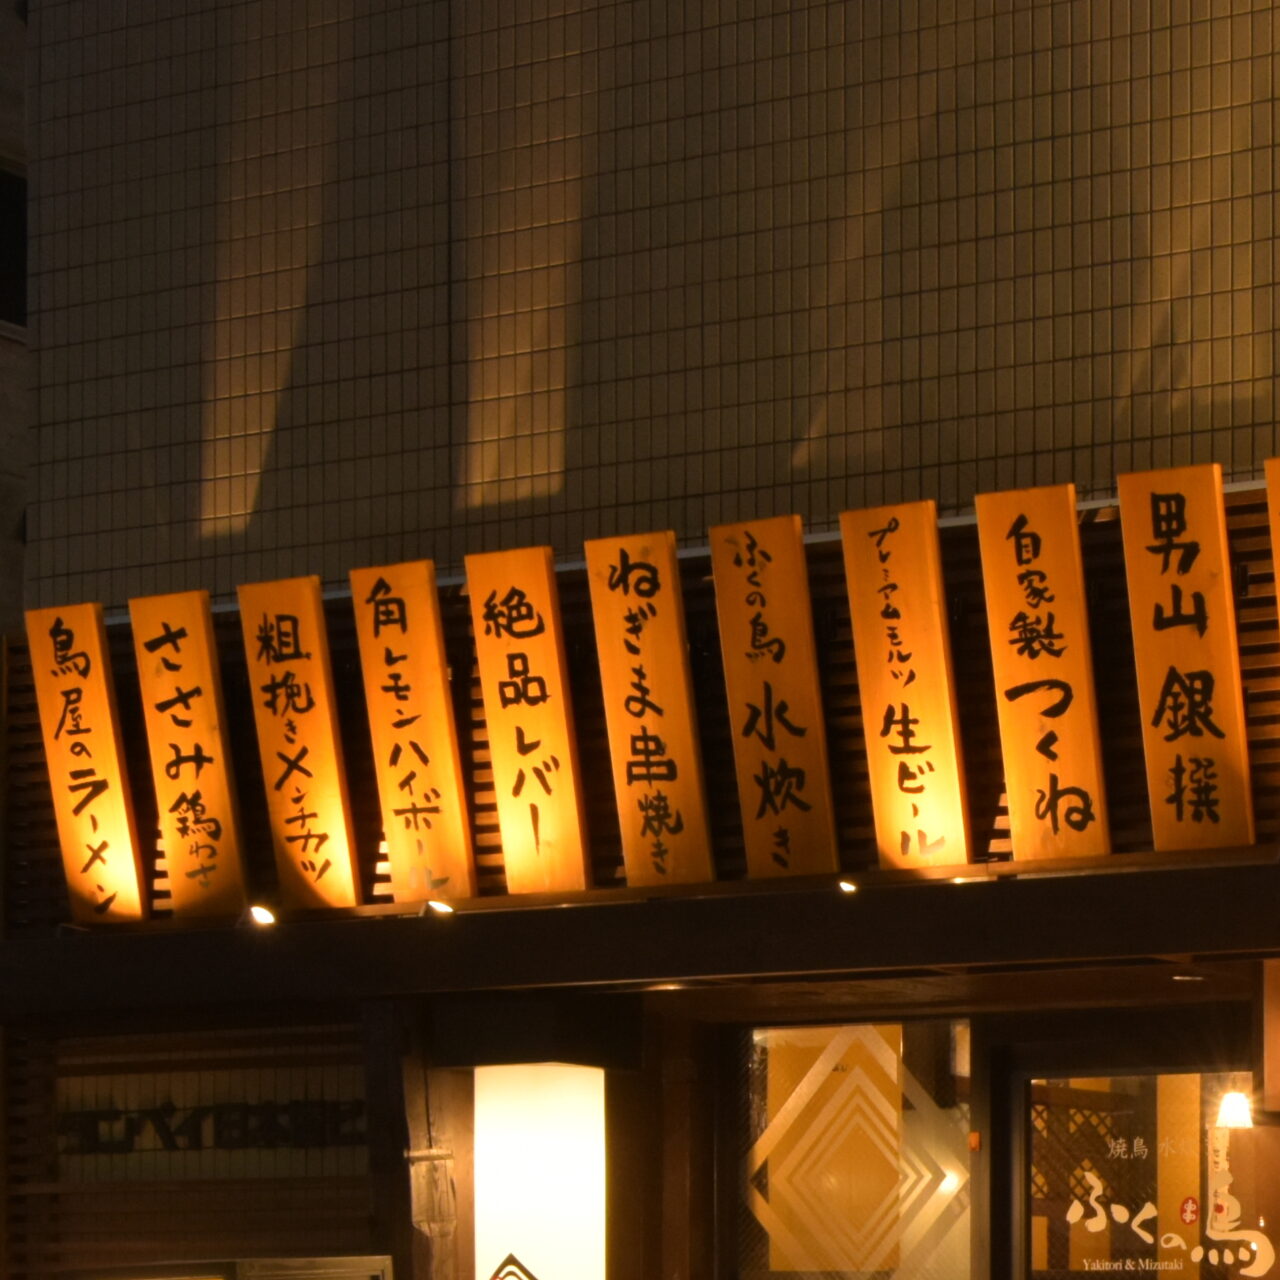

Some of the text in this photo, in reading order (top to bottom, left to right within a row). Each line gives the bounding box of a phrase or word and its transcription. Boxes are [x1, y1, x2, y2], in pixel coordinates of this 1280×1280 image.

[49, 617, 117, 914] 鳥屋のラーメン
[144, 622, 221, 888] ささみ鶏わさ
[256, 614, 331, 881] 粗挽きメンチカツ
[365, 577, 449, 889] 角レモンハイボール
[481, 586, 560, 855] 絶品レバー
[607, 547, 683, 875] ねぎま串焼き
[1005, 513, 1096, 835] 自家製つくね
[1066, 1169, 1275, 1278] ふくの鳥
[1083, 1258, 1183, 1271] Yakitori & Mizutaki
[1108, 1136, 1148, 1159] 焼鳥
